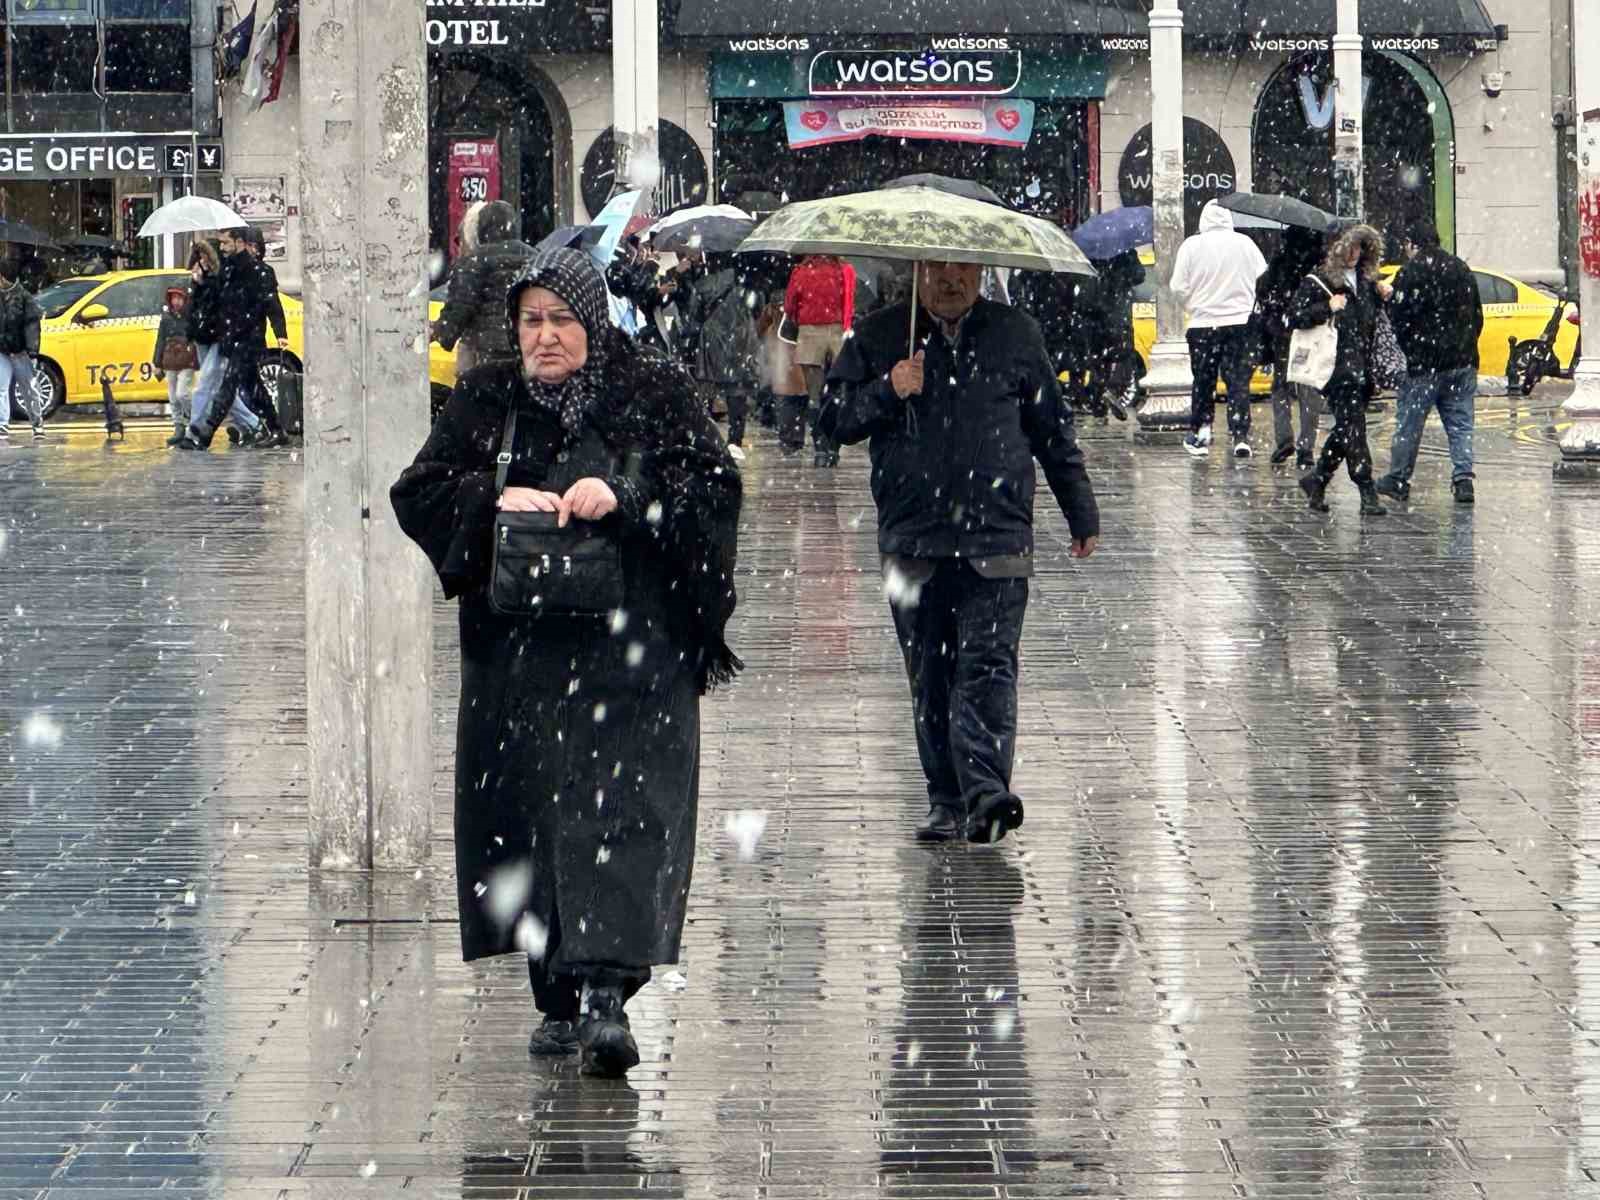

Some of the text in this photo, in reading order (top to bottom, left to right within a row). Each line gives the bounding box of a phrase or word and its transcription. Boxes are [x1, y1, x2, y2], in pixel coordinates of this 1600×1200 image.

[425, 20, 509, 45] OTEL
[729, 38, 809, 51] watsons
[932, 38, 1008, 49] watsons
[1101, 39, 1149, 50] watsons
[1249, 38, 1329, 50] watsons
[1371, 38, 1439, 50] watsons
[837, 57, 993, 82] watsons
[46, 147, 155, 171] OFFICE
[202, 148, 216, 166] ¥
[1127, 173, 1232, 189] wons
[86, 362, 152, 385] TCZ 9
